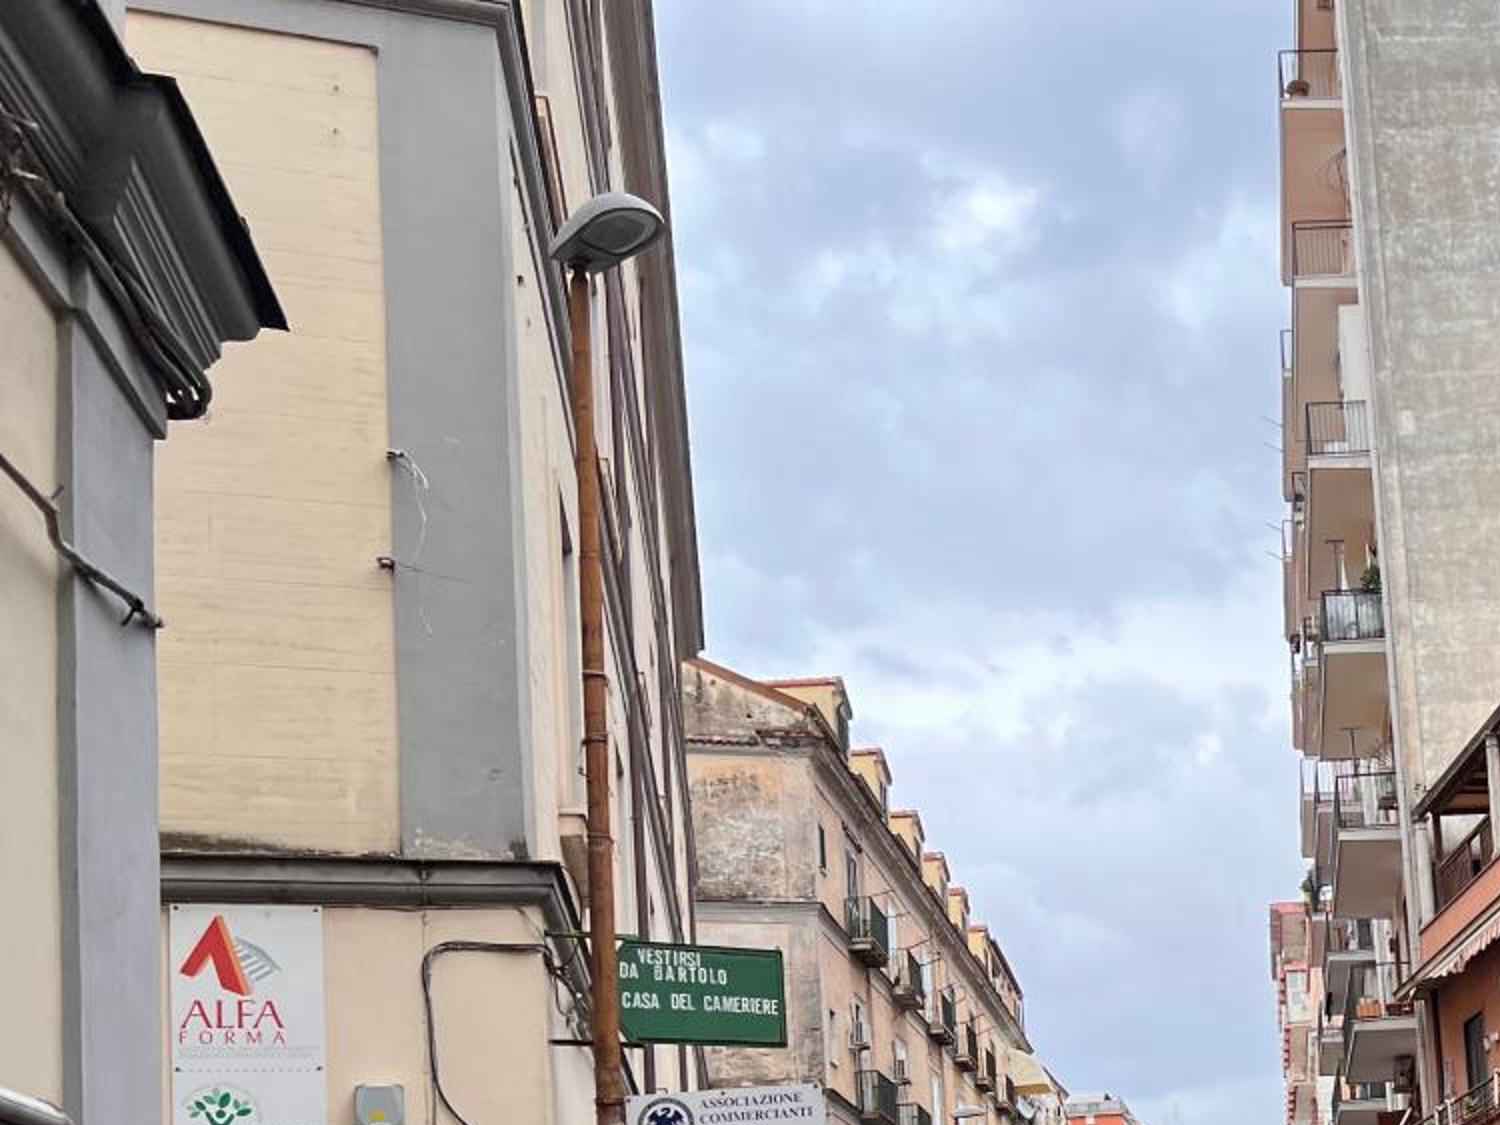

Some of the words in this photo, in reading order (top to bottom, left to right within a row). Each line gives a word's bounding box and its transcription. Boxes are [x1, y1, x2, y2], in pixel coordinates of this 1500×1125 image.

[637, 948, 701, 967] VESTIRSI
[619, 961, 639, 979] DA
[653, 964, 728, 985] BARTOLO
[621, 991, 661, 1009] CASA
[671, 993, 696, 1011] DEL
[703, 994, 779, 1015] CAMERIERE
[180, 999, 285, 1029] ALFA
[178, 1030, 286, 1045] FORMA
[700, 1091, 801, 1110] ASSOCIAZIONE
[699, 1105, 814, 1125] COMMERCIANTI
